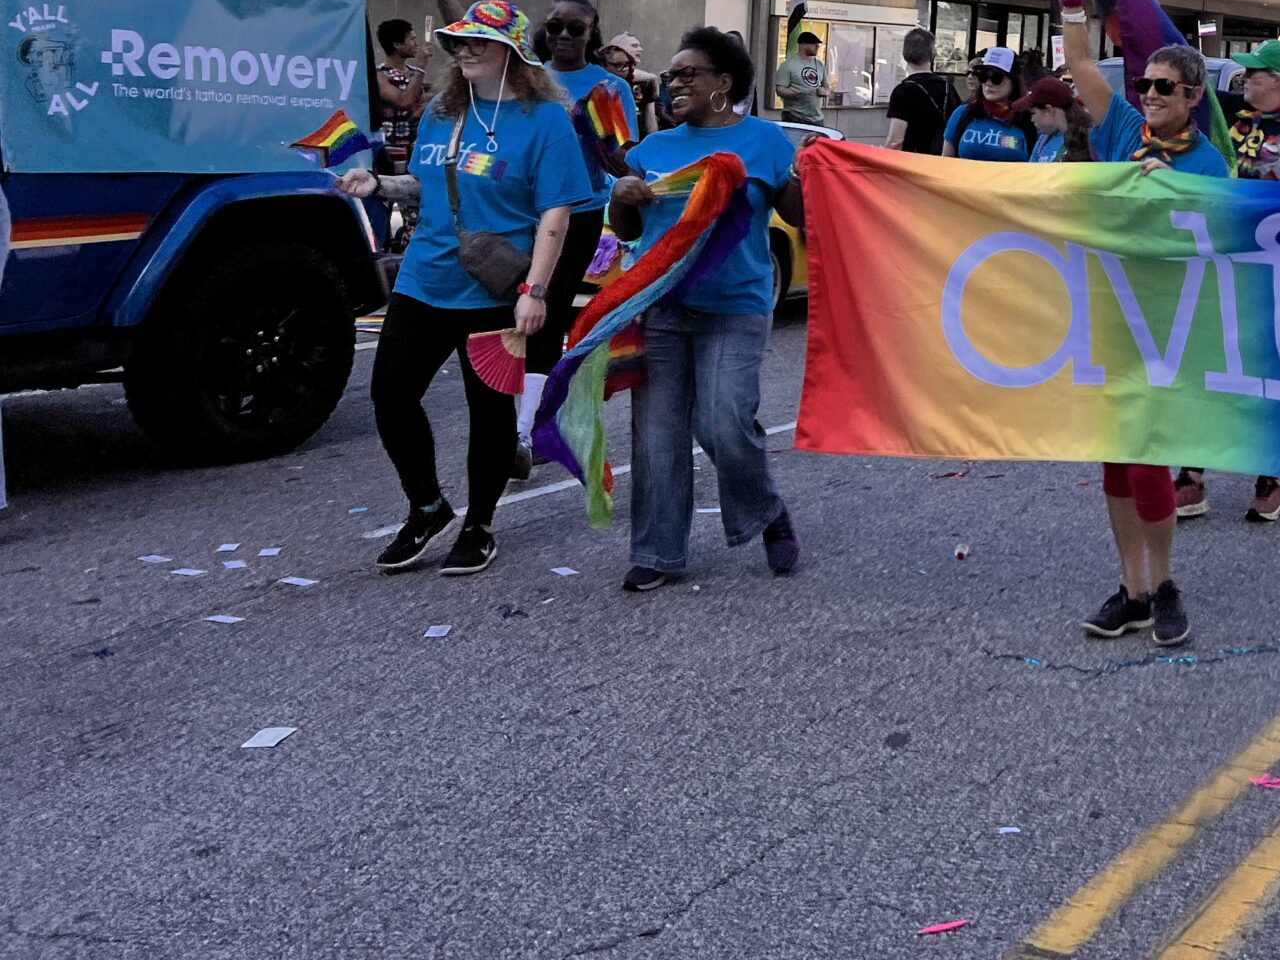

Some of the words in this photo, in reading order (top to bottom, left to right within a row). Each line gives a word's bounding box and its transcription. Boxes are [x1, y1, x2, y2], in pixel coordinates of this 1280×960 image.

[8, 3, 68, 32] Y'ALL
[101, 29, 358, 101] Removery
[47, 81, 99, 116] ALL
[112, 83, 139, 98] The
[143, 86, 191, 101] world's
[195, 89, 233, 103] tattoo
[236, 93, 287, 106] removal
